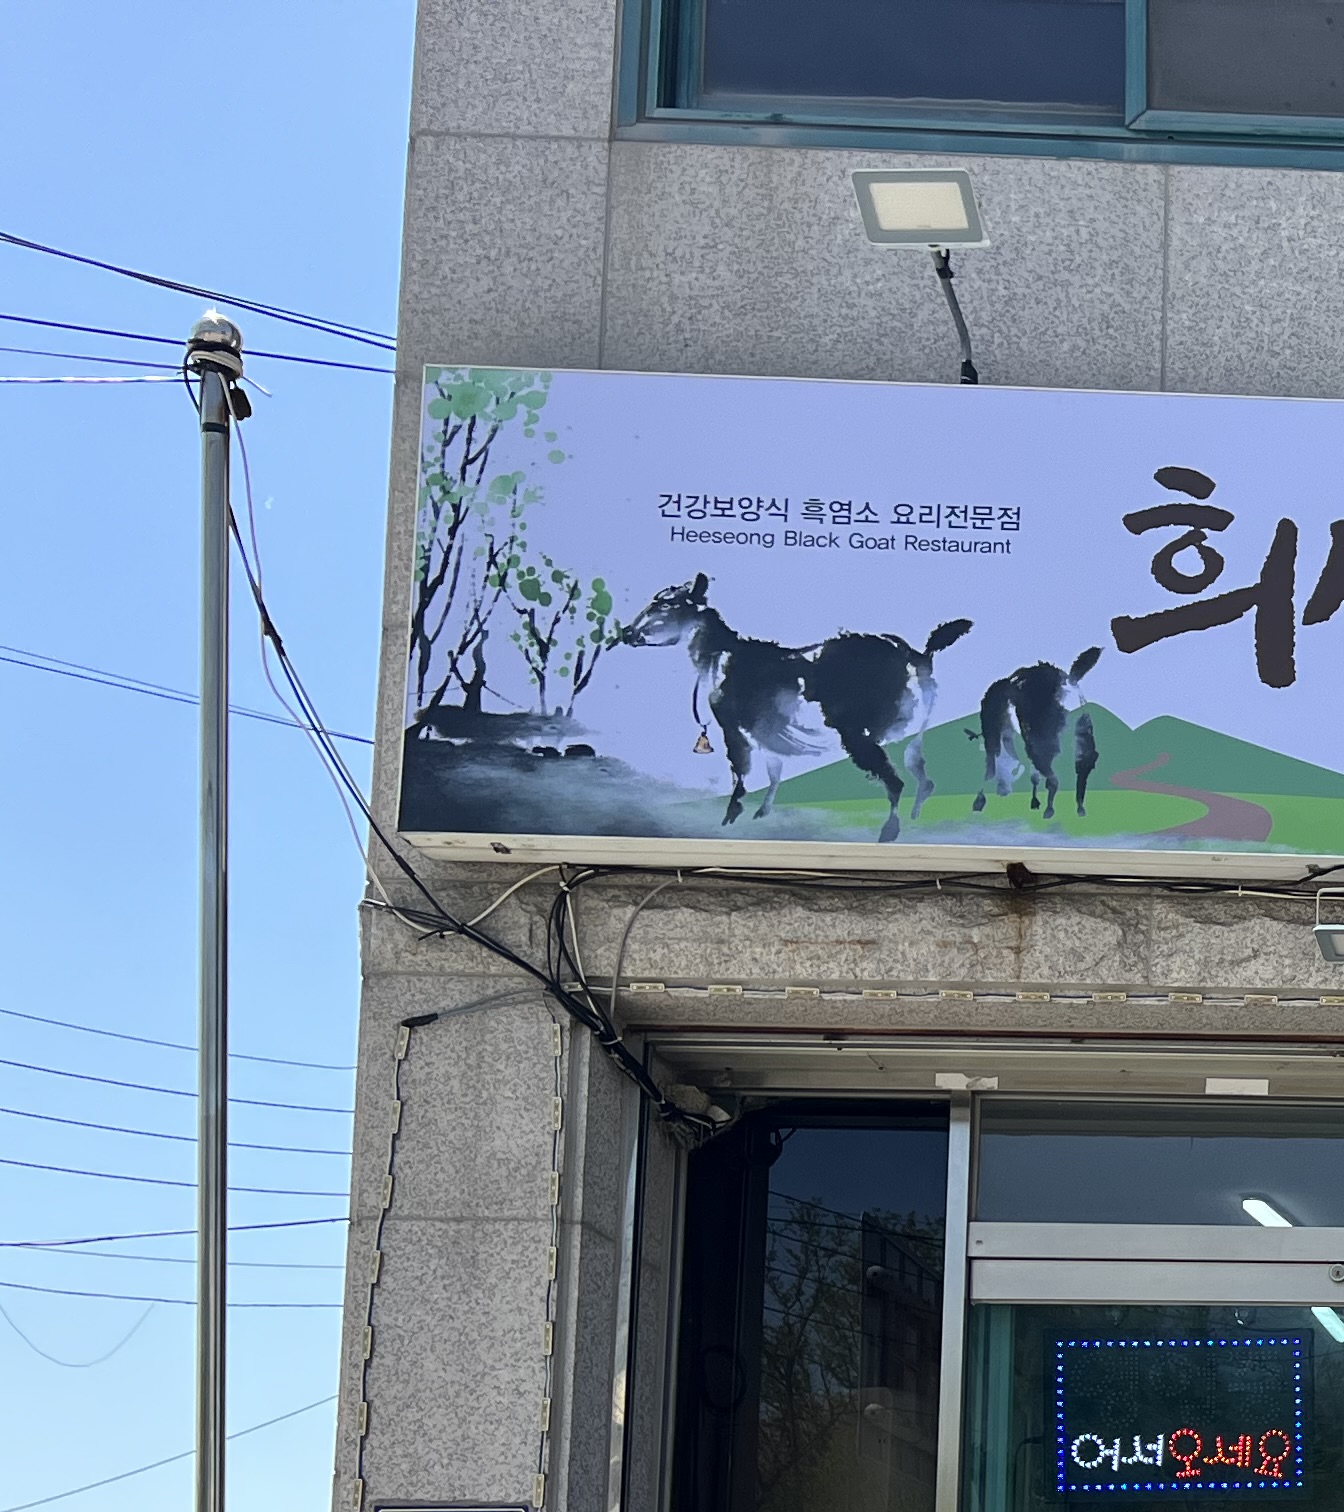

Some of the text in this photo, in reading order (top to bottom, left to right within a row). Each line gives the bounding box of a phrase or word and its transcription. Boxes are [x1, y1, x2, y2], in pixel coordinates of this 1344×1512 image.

[657, 493, 1022, 532] 건강보양식 흑염소 요리전문점
[670, 526, 1012, 555] Heeseong Black Goat Restaurant
